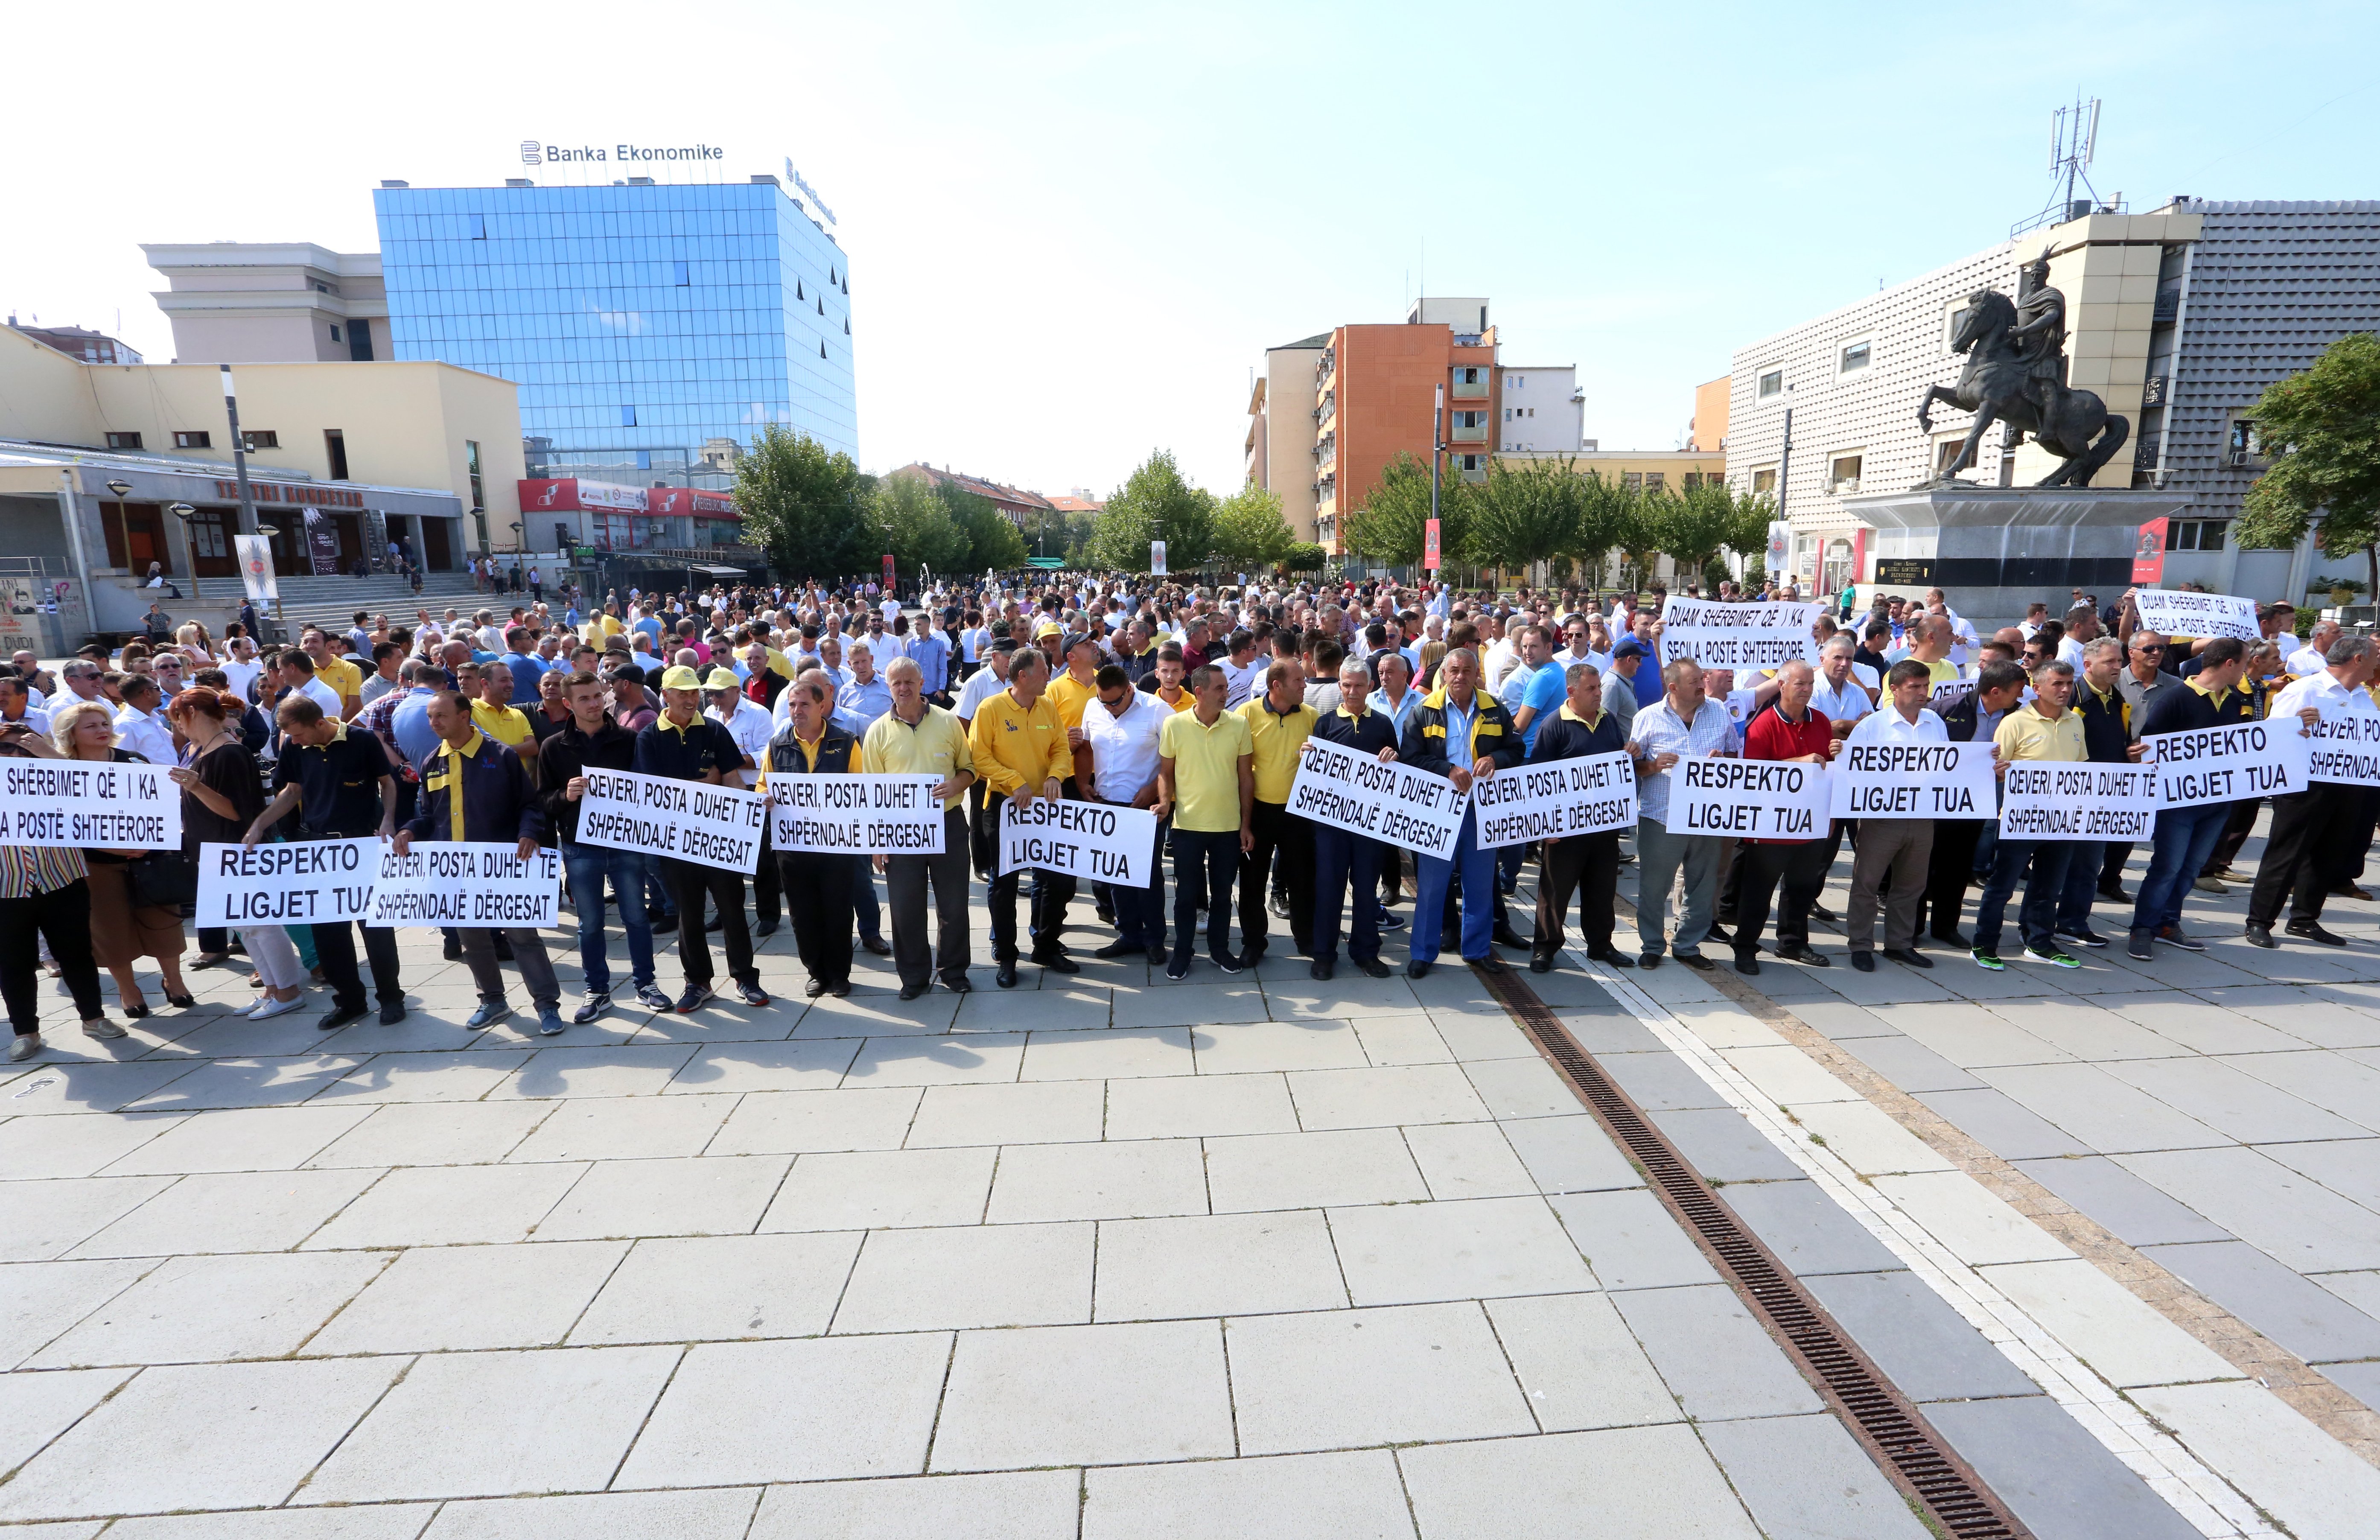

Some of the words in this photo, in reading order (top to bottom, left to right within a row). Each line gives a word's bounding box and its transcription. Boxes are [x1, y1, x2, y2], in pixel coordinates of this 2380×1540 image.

[547, 146, 607, 162] Banka
[617, 144, 723, 160] Ekonomike
[217, 481, 280, 501] TETRI
[1669, 605, 1700, 627] DUAM
[1701, 606, 1761, 627] SHËRBIMET
[1761, 605, 1779, 628] QË
[1781, 609, 1788, 627] I
[1789, 609, 1805, 627] KA
[2142, 595, 2167, 610] DUAM
[2169, 594, 2214, 612] SHËRBIMET
[2216, 598, 2228, 614] QË
[2232, 602, 2236, 615] I
[2237, 603, 2249, 618] KA
[2148, 617, 2178, 631] SECILA
[2181, 617, 2207, 633] POSTË
[1706, 636, 1737, 663] POSTË
[1742, 636, 1806, 663] SHTETËRORE
[1849, 746, 1959, 771] RESPEKTO
[2156, 726, 2266, 763] RESPEKTO
[1305, 747, 1353, 787] QEVERI,
[1354, 761, 1397, 795] POSTA
[1400, 776, 1445, 808] DUHET
[1686, 761, 1803, 793] RESPEKTO
[2310, 749, 2380, 780] SHPËRNDA
[8, 763, 89, 797] SHËRBIMET
[98, 767, 116, 799] QË
[128, 773, 131, 799] I
[139, 774, 158, 799] KA
[1478, 776, 1525, 807] QEVERI,
[1527, 770, 1567, 798] POSTA
[1571, 762, 1610, 791] DUHET
[1615, 754, 1632, 784] TË
[2009, 769, 2052, 799] QEVERI,
[2056, 771, 2092, 795] POSTA
[2098, 772, 2137, 797] DUHET
[2143, 769, 2156, 797] TË
[2165, 770, 2234, 802] LIGJET
[2245, 764, 2287, 792] TUA
[588, 774, 640, 808] QEVERI,
[645, 782, 687, 813] POSTA
[694, 791, 739, 822] DUHET
[746, 798, 762, 827] TË
[772, 782, 821, 812] QEVERI,
[825, 783, 867, 808] POSTA
[875, 784, 917, 808] DUHET
[1850, 787, 1920, 812] LIGJET
[1932, 787, 1974, 812] TUA
[18, 808, 64, 839] POSTË
[73, 810, 163, 842] SHTETËRORE
[779, 817, 861, 847] SHPËRNDAJË
[868, 819, 936, 848] DËRGESAT
[1008, 802, 1115, 836] RESPEKTO
[1296, 785, 1380, 831] SHPËRNDAJË
[1382, 809, 1451, 852] DËRGESAT
[1485, 804, 1563, 843] SHPËRNDAJË
[1569, 798, 1630, 830] DËRGESAT
[1688, 803, 1762, 831] LIGJET
[1774, 808, 1812, 833] TUA
[2007, 804, 2082, 833] SHPËRNDAJË
[2085, 806, 2149, 835] DËRGESAT
[586, 812, 676, 851] SHPËRNDAJË
[682, 827, 752, 866] DËRGESAT
[221, 844, 359, 876] RESPEKTO
[382, 851, 426, 881] QEVERI,
[430, 851, 475, 878] POSTA
[484, 853, 529, 878] DUHET
[540, 851, 557, 879] TË
[1012, 839, 1079, 869] LIGJET
[1090, 849, 1129, 879] TUA
[226, 890, 318, 919] LIGJET
[376, 889, 466, 920] SHPËRNDAJË
[475, 889, 550, 920] DËRGESAT
